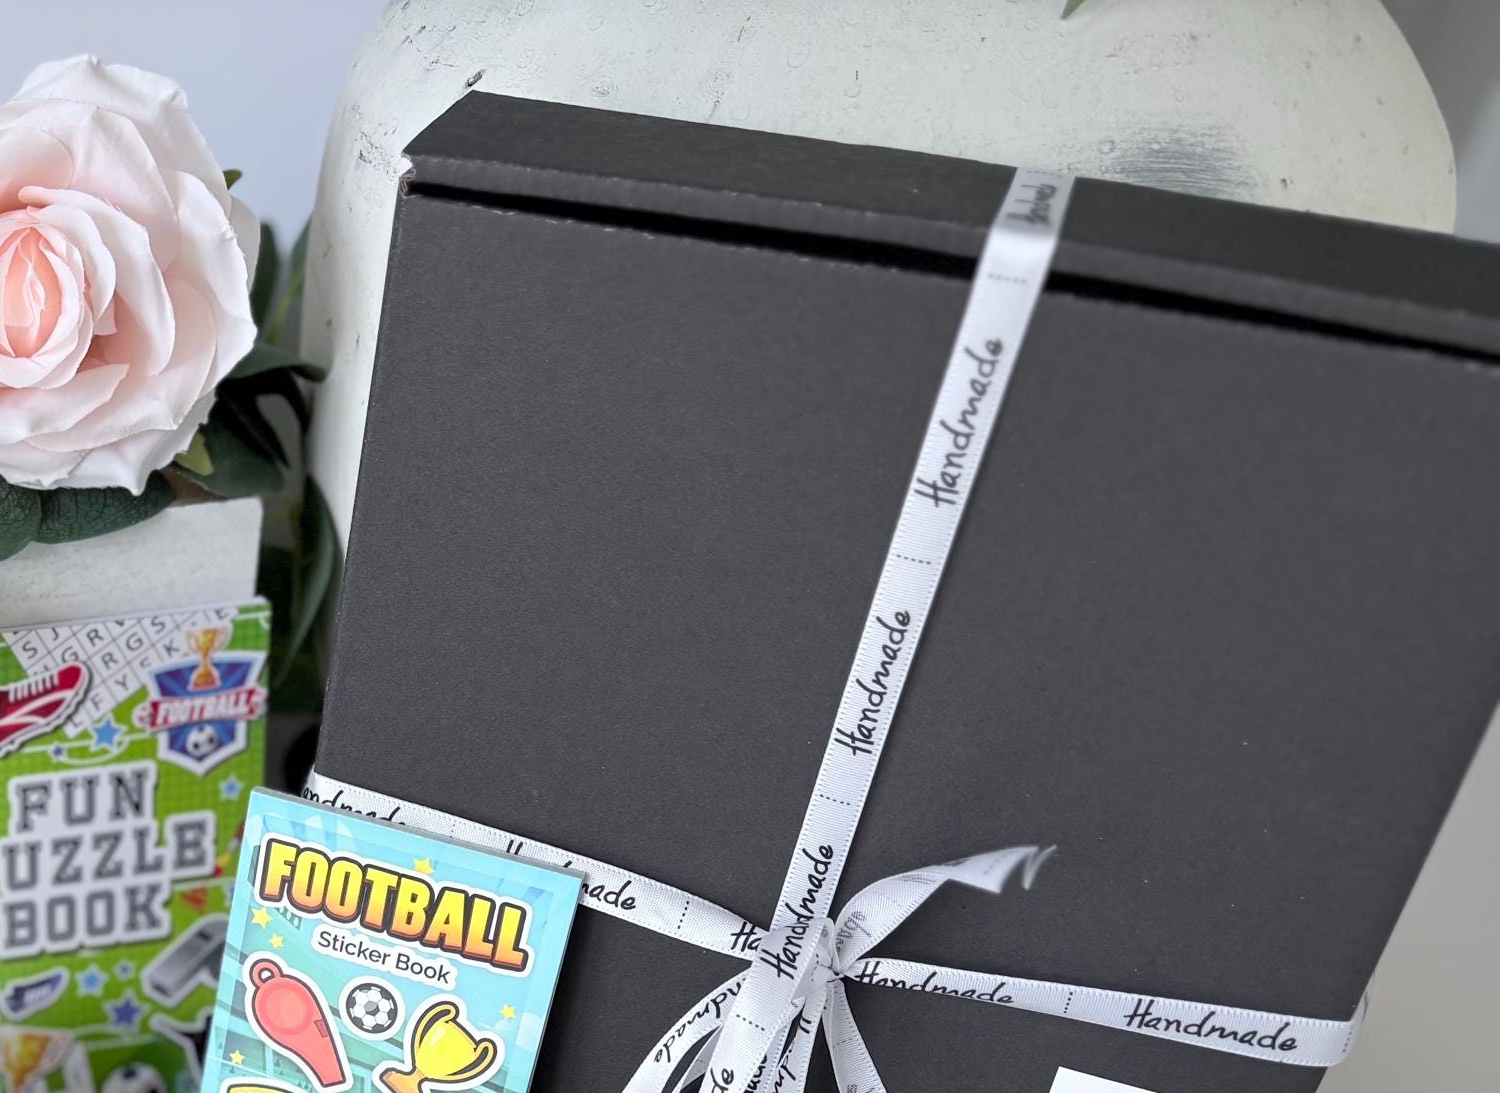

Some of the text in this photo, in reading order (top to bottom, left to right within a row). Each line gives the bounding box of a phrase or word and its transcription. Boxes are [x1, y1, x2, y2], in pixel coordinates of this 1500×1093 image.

[914, 336, 1003, 508] Handmade
[835, 608, 910, 756] Handmade
[15, 769, 150, 832] FUN
[2, 882, 162, 950] BOOK
[258, 837, 529, 972] FOOTBALL
[317, 930, 451, 984] Sticker Book
[1123, 998, 1298, 1053] Handmade
